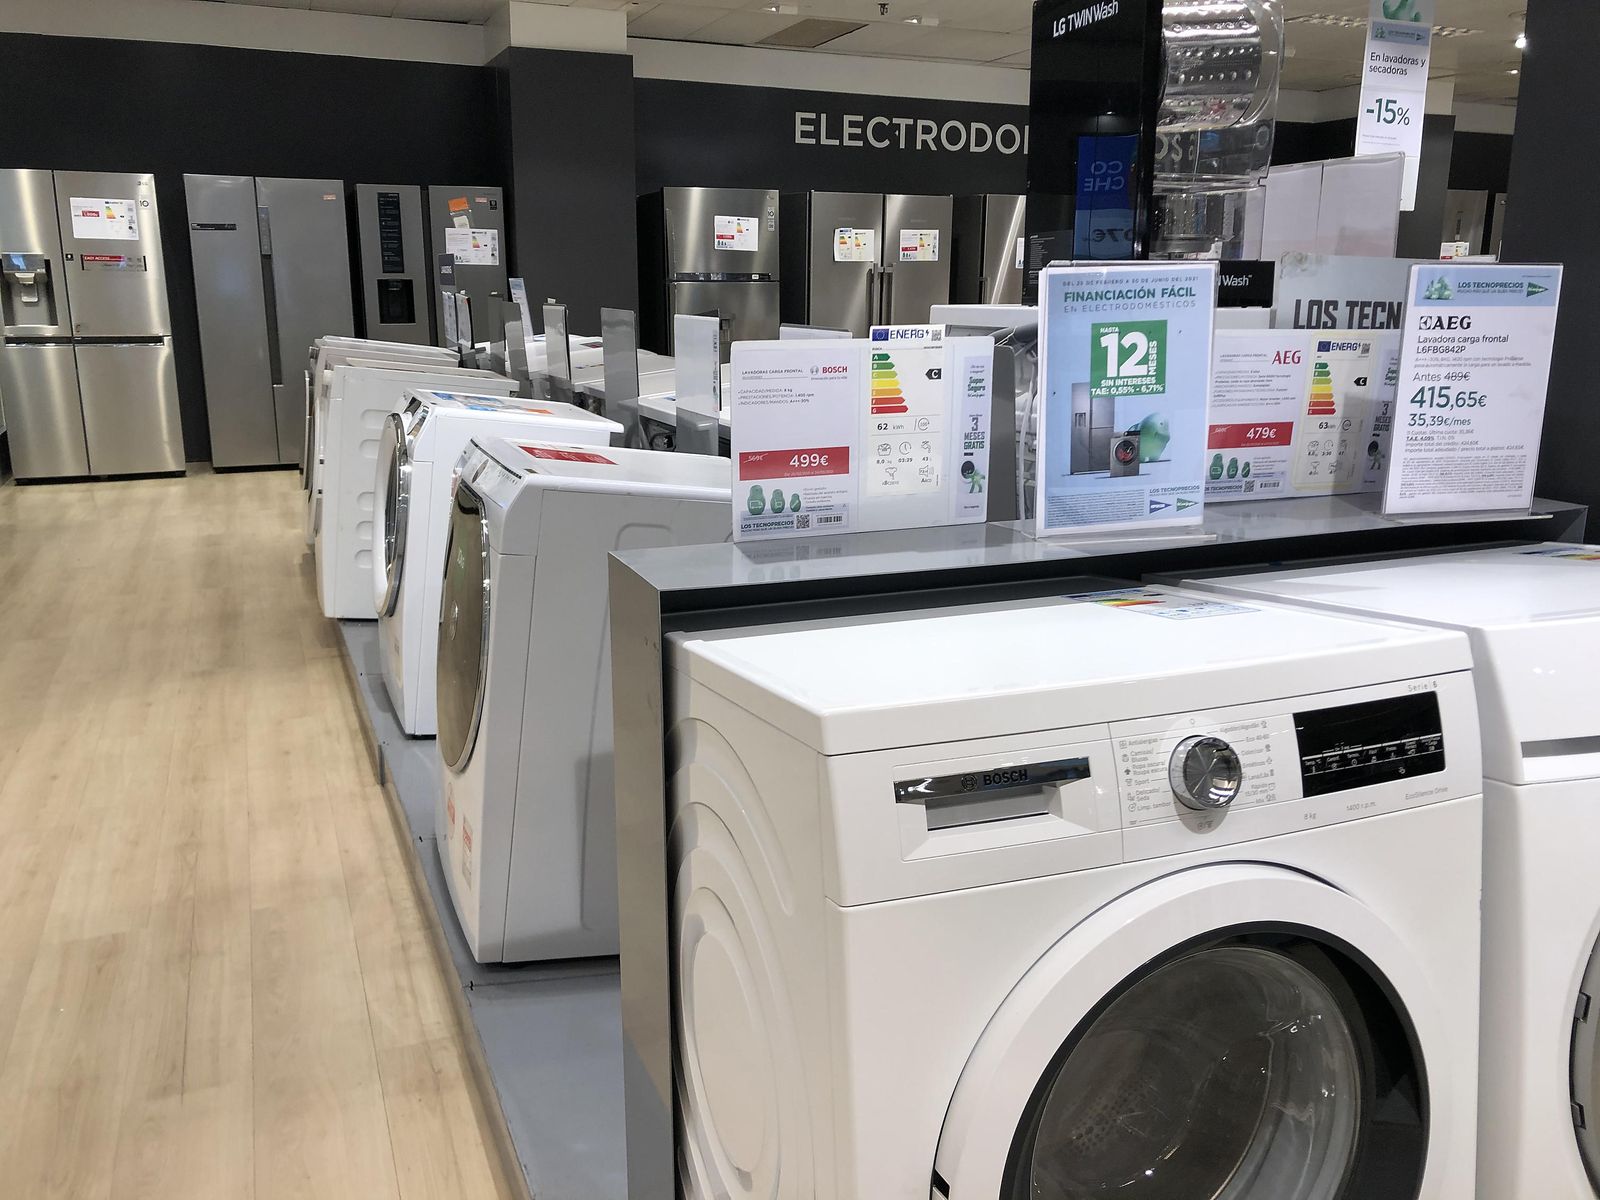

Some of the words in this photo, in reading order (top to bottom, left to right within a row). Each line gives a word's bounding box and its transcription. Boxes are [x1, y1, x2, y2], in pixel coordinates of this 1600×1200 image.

[1052, 17, 1066, 38] LG
[1370, 52, 1380, 61] En
[1382, 53, 1419, 66] lavadoras
[1420, 59, 1426, 67] y
[1369, 65, 1408, 76] secadoras
[1366, 97, 1410, 126] -15%
[1218, 275, 1249, 287] Wash
[1473, 281, 1524, 289] TECNOPRECIOS
[1064, 286, 1156, 303] FINANCIACIÓN
[1161, 284, 1196, 298] FÁCIL
[1064, 305, 1077, 313] EN
[1293, 298, 1338, 329] LOS
[1433, 315, 1472, 330] AEG
[1100, 326, 1119, 334] HASTA
[1417, 335, 1456, 344] Lavadora
[1457, 337, 1480, 345] carga
[1482, 334, 1510, 343] frontal
[1100, 331, 1149, 378] 12
[1148, 340, 1158, 376] MESES
[1271, 349, 1302, 365] AEG
[822, 366, 848, 374] BOSCH
[931, 370, 939, 379] C
[1412, 372, 1442, 381] Antes
[1444, 371, 1471, 381] 489€
[1101, 379, 1114, 387] SIN
[1115, 376, 1156, 387] INTERESES
[1091, 387, 1109, 396] TAE:
[1110, 385, 1135, 395] 0,55%
[1141, 383, 1164, 393] 6,71%
[1410, 385, 1487, 411] 415,65€
[1382, 403, 1389, 416] 3
[971, 417, 979, 432] 3
[1318, 421, 1329, 429] 63
[1407, 413, 1472, 428] 35,39€/mes
[963, 431, 986, 441] MESES
[1246, 427, 1277, 440] 479€
[963, 441, 985, 450] GRATIS
[789, 453, 829, 468] 499€
[752, 520, 794, 529] TECNOPRECIOS
[1408, 683, 1428, 692] Serie
[983, 769, 1028, 786] BOSCH
[1346, 803, 1361, 811] 1400
[1309, 812, 1317, 820] kg
